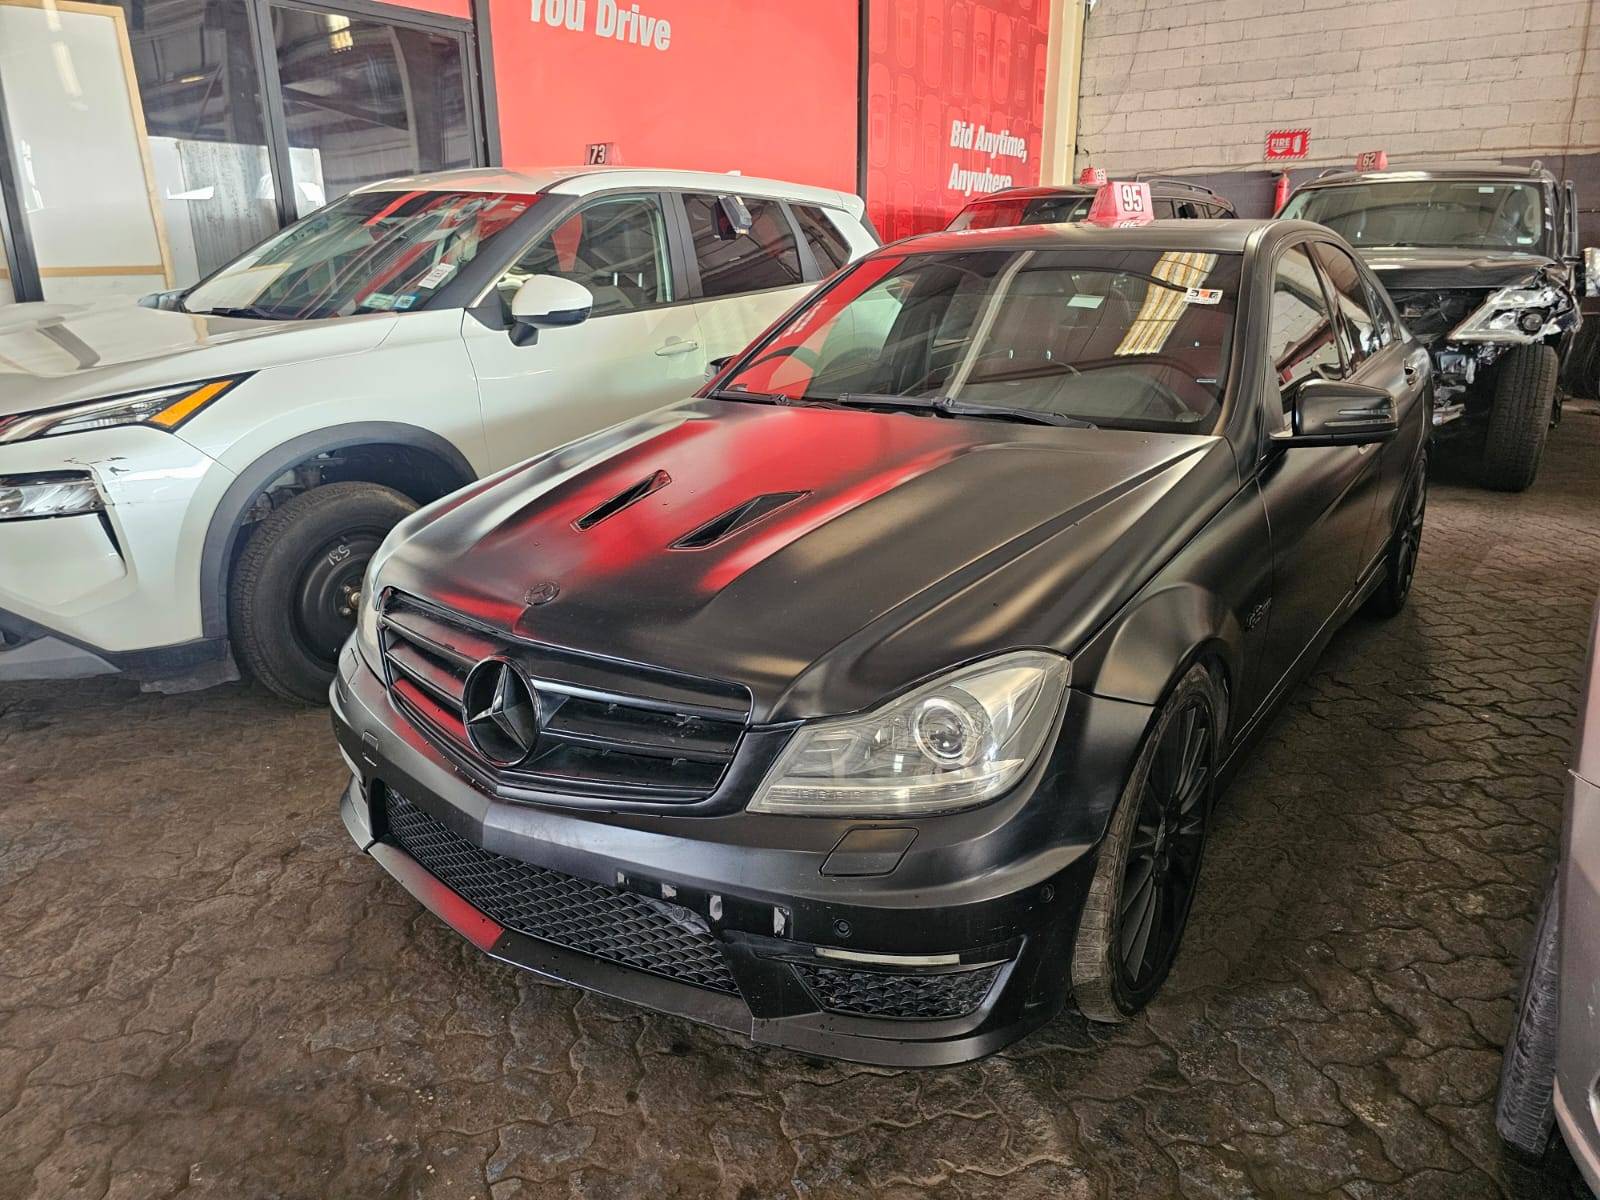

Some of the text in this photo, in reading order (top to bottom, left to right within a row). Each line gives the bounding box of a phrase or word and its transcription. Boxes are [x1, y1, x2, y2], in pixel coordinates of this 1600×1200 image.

[530, 0, 672, 51] You Drive
[590, 144, 606, 165] 73
[950, 119, 1028, 164] Bid Anytime,
[1271, 137, 1291, 148] FIRE
[1121, 185, 1144, 212] 95
